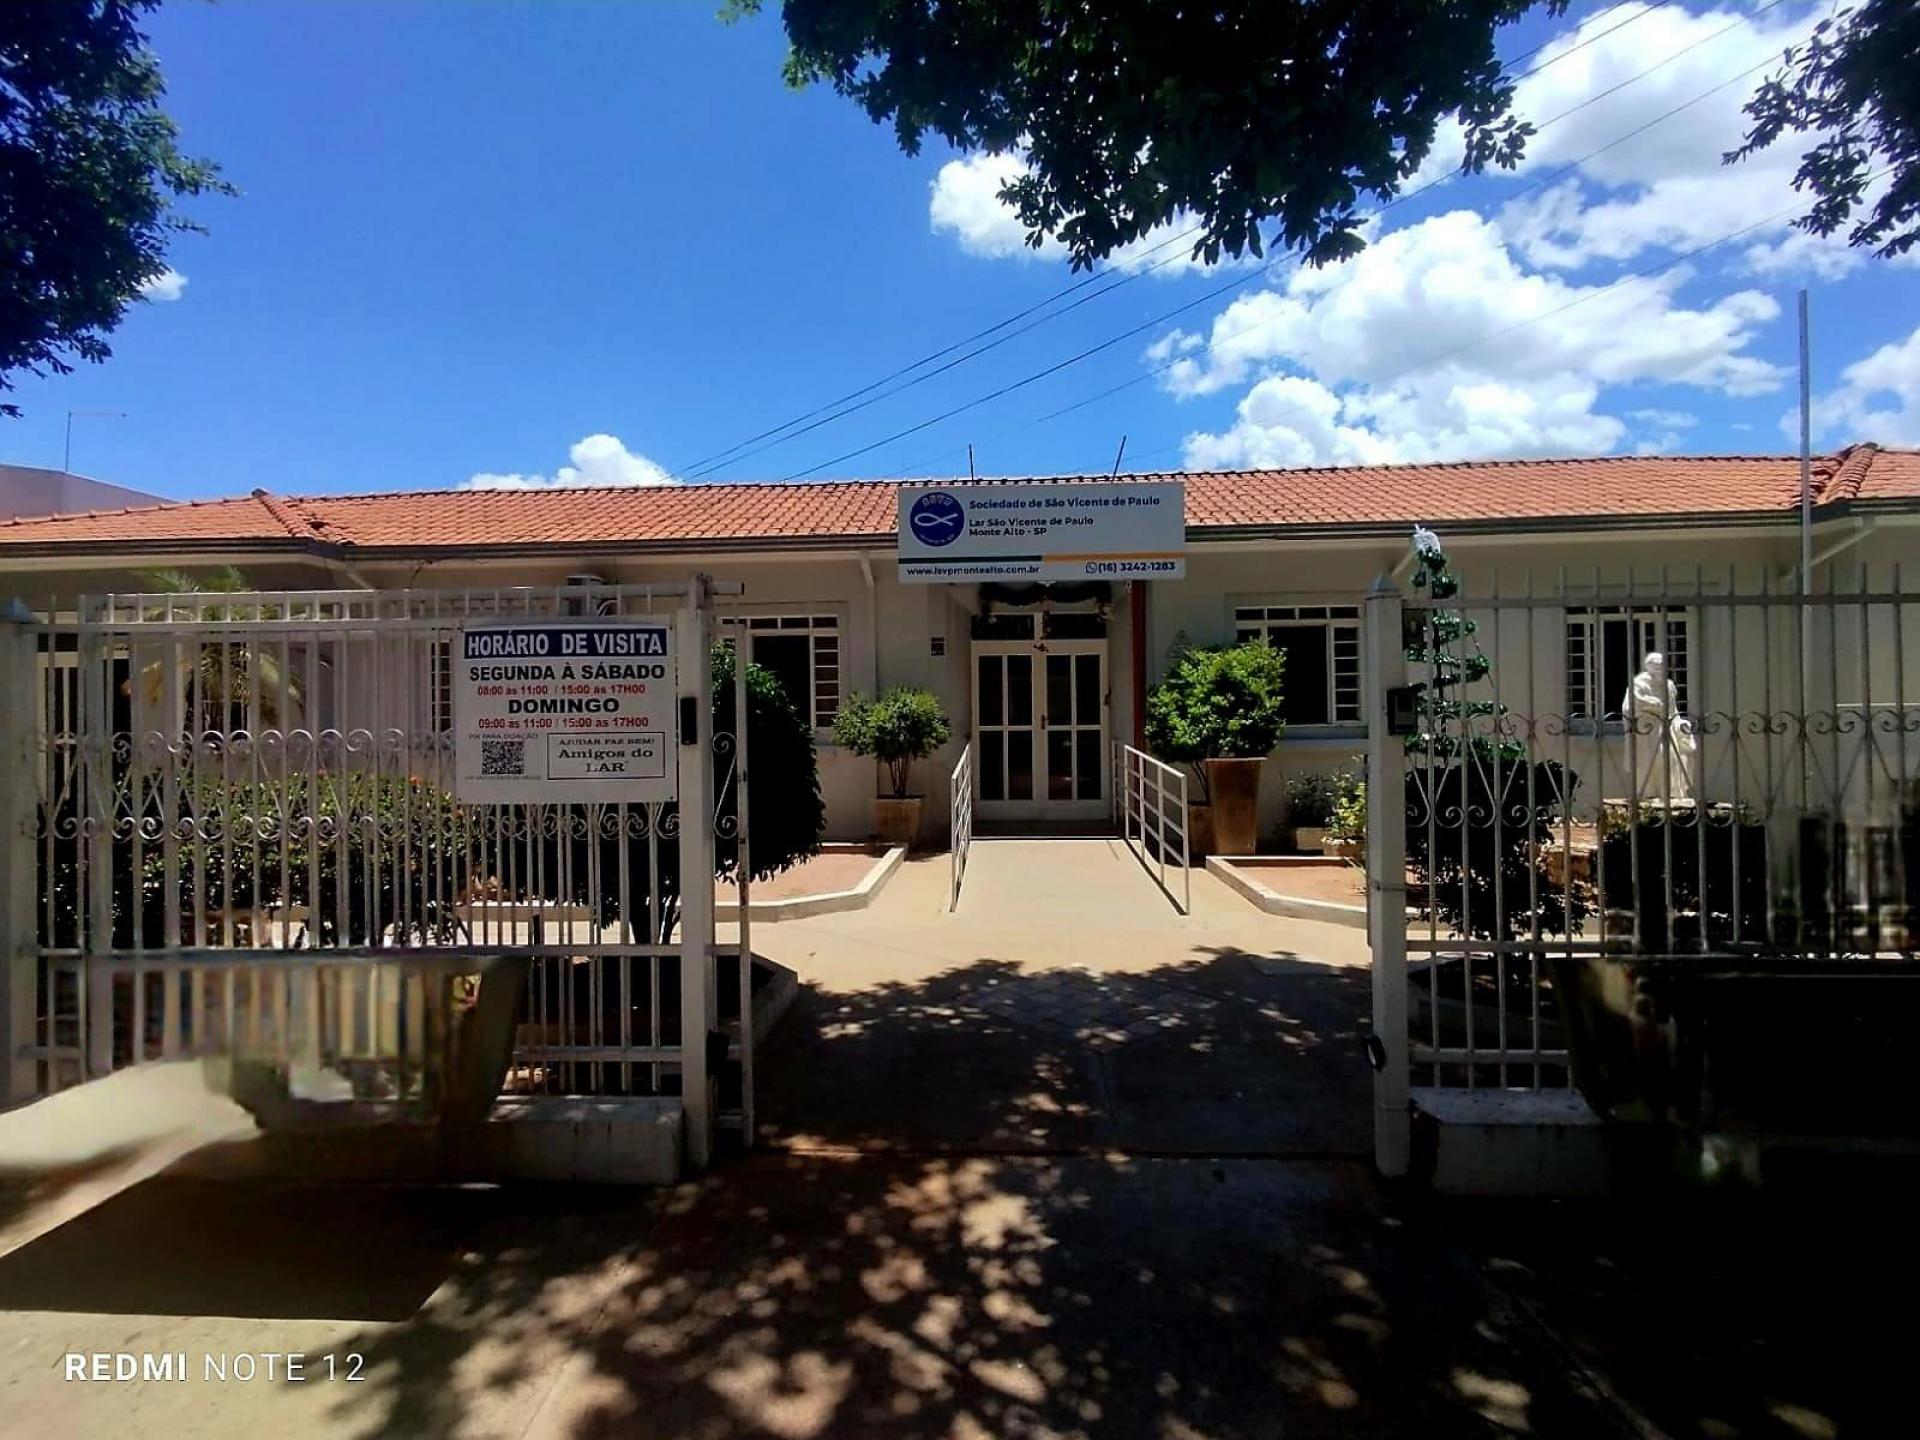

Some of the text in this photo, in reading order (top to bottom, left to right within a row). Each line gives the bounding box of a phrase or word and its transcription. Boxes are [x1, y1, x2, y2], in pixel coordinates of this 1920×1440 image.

[969, 495, 1160, 509] Sociedade de São Vicente de Paulo
[969, 515, 1094, 527] Lar São Vicente de Paulo
[969, 527, 1001, 537] Monte
[1003, 527, 1026, 536] Alto
[1034, 527, 1047, 536] SP
[1098, 560, 1176, 573] (16) 3242-1283
[468, 630, 663, 656] HORÁRIO DE VISITA
[470, 665, 556, 682] SEGUNDA
[581, 661, 665, 680] SÁBADO
[479, 685, 504, 696] 08:00
[521, 684, 548, 695] 11:00
[561, 684, 591, 695] 15:00
[611, 683, 646, 694] 17H00
[508, 698, 620, 714] DOMINGO
[478, 718, 506, 729] 09:00
[524, 718, 553, 729] 11:00
[563, 717, 593, 728] 15:00
[612, 716, 649, 728] 17H00
[558, 748, 654, 761] Amigos do
[585, 761, 625, 773] LAR
